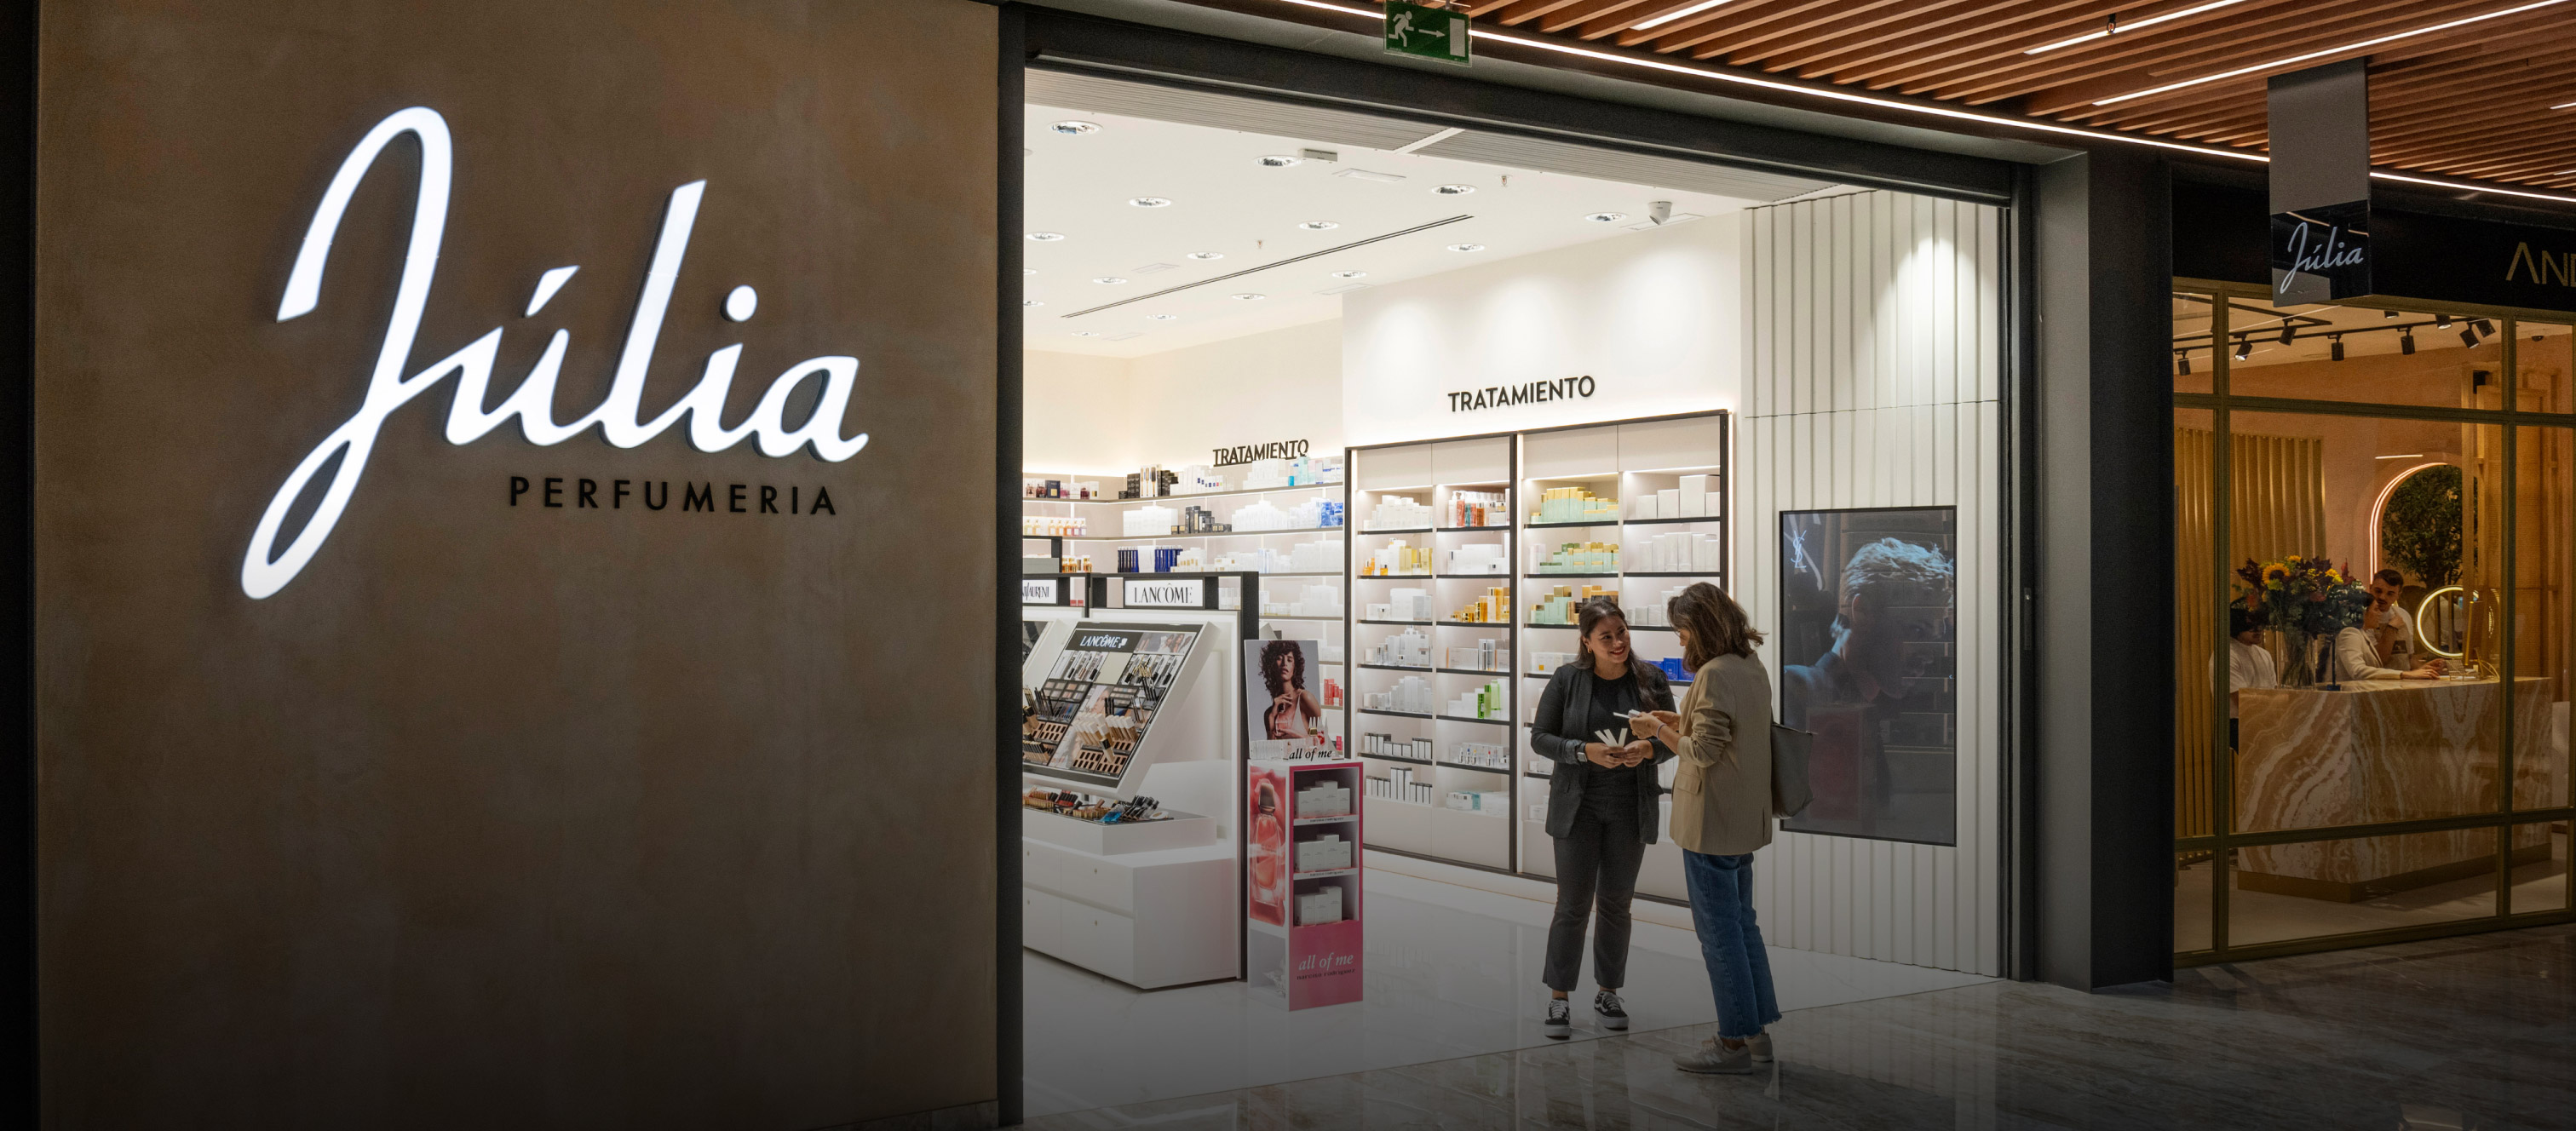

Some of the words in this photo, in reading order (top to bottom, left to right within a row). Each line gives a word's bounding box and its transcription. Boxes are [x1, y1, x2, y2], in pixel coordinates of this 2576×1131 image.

[2280, 221, 2364, 294] Júlia
[2505, 242, 2576, 287] AN
[240, 106, 868, 600] Júlia
[1447, 375, 1596, 412] TRATAMIENTO
[1212, 439, 1309, 467] TRATAMIENTO
[509, 476, 837, 515] PERFUMERIA
[1134, 583, 1193, 604] LANCÔME
[1079, 634, 1121, 648] LANCÔME
[1289, 748, 1302, 760] all
[1305, 747, 1317, 761] of
[1318, 749, 1332, 758] me
[1298, 955, 1316, 971] all
[1319, 952, 1335, 971] of
[1335, 954, 1354, 966] me
